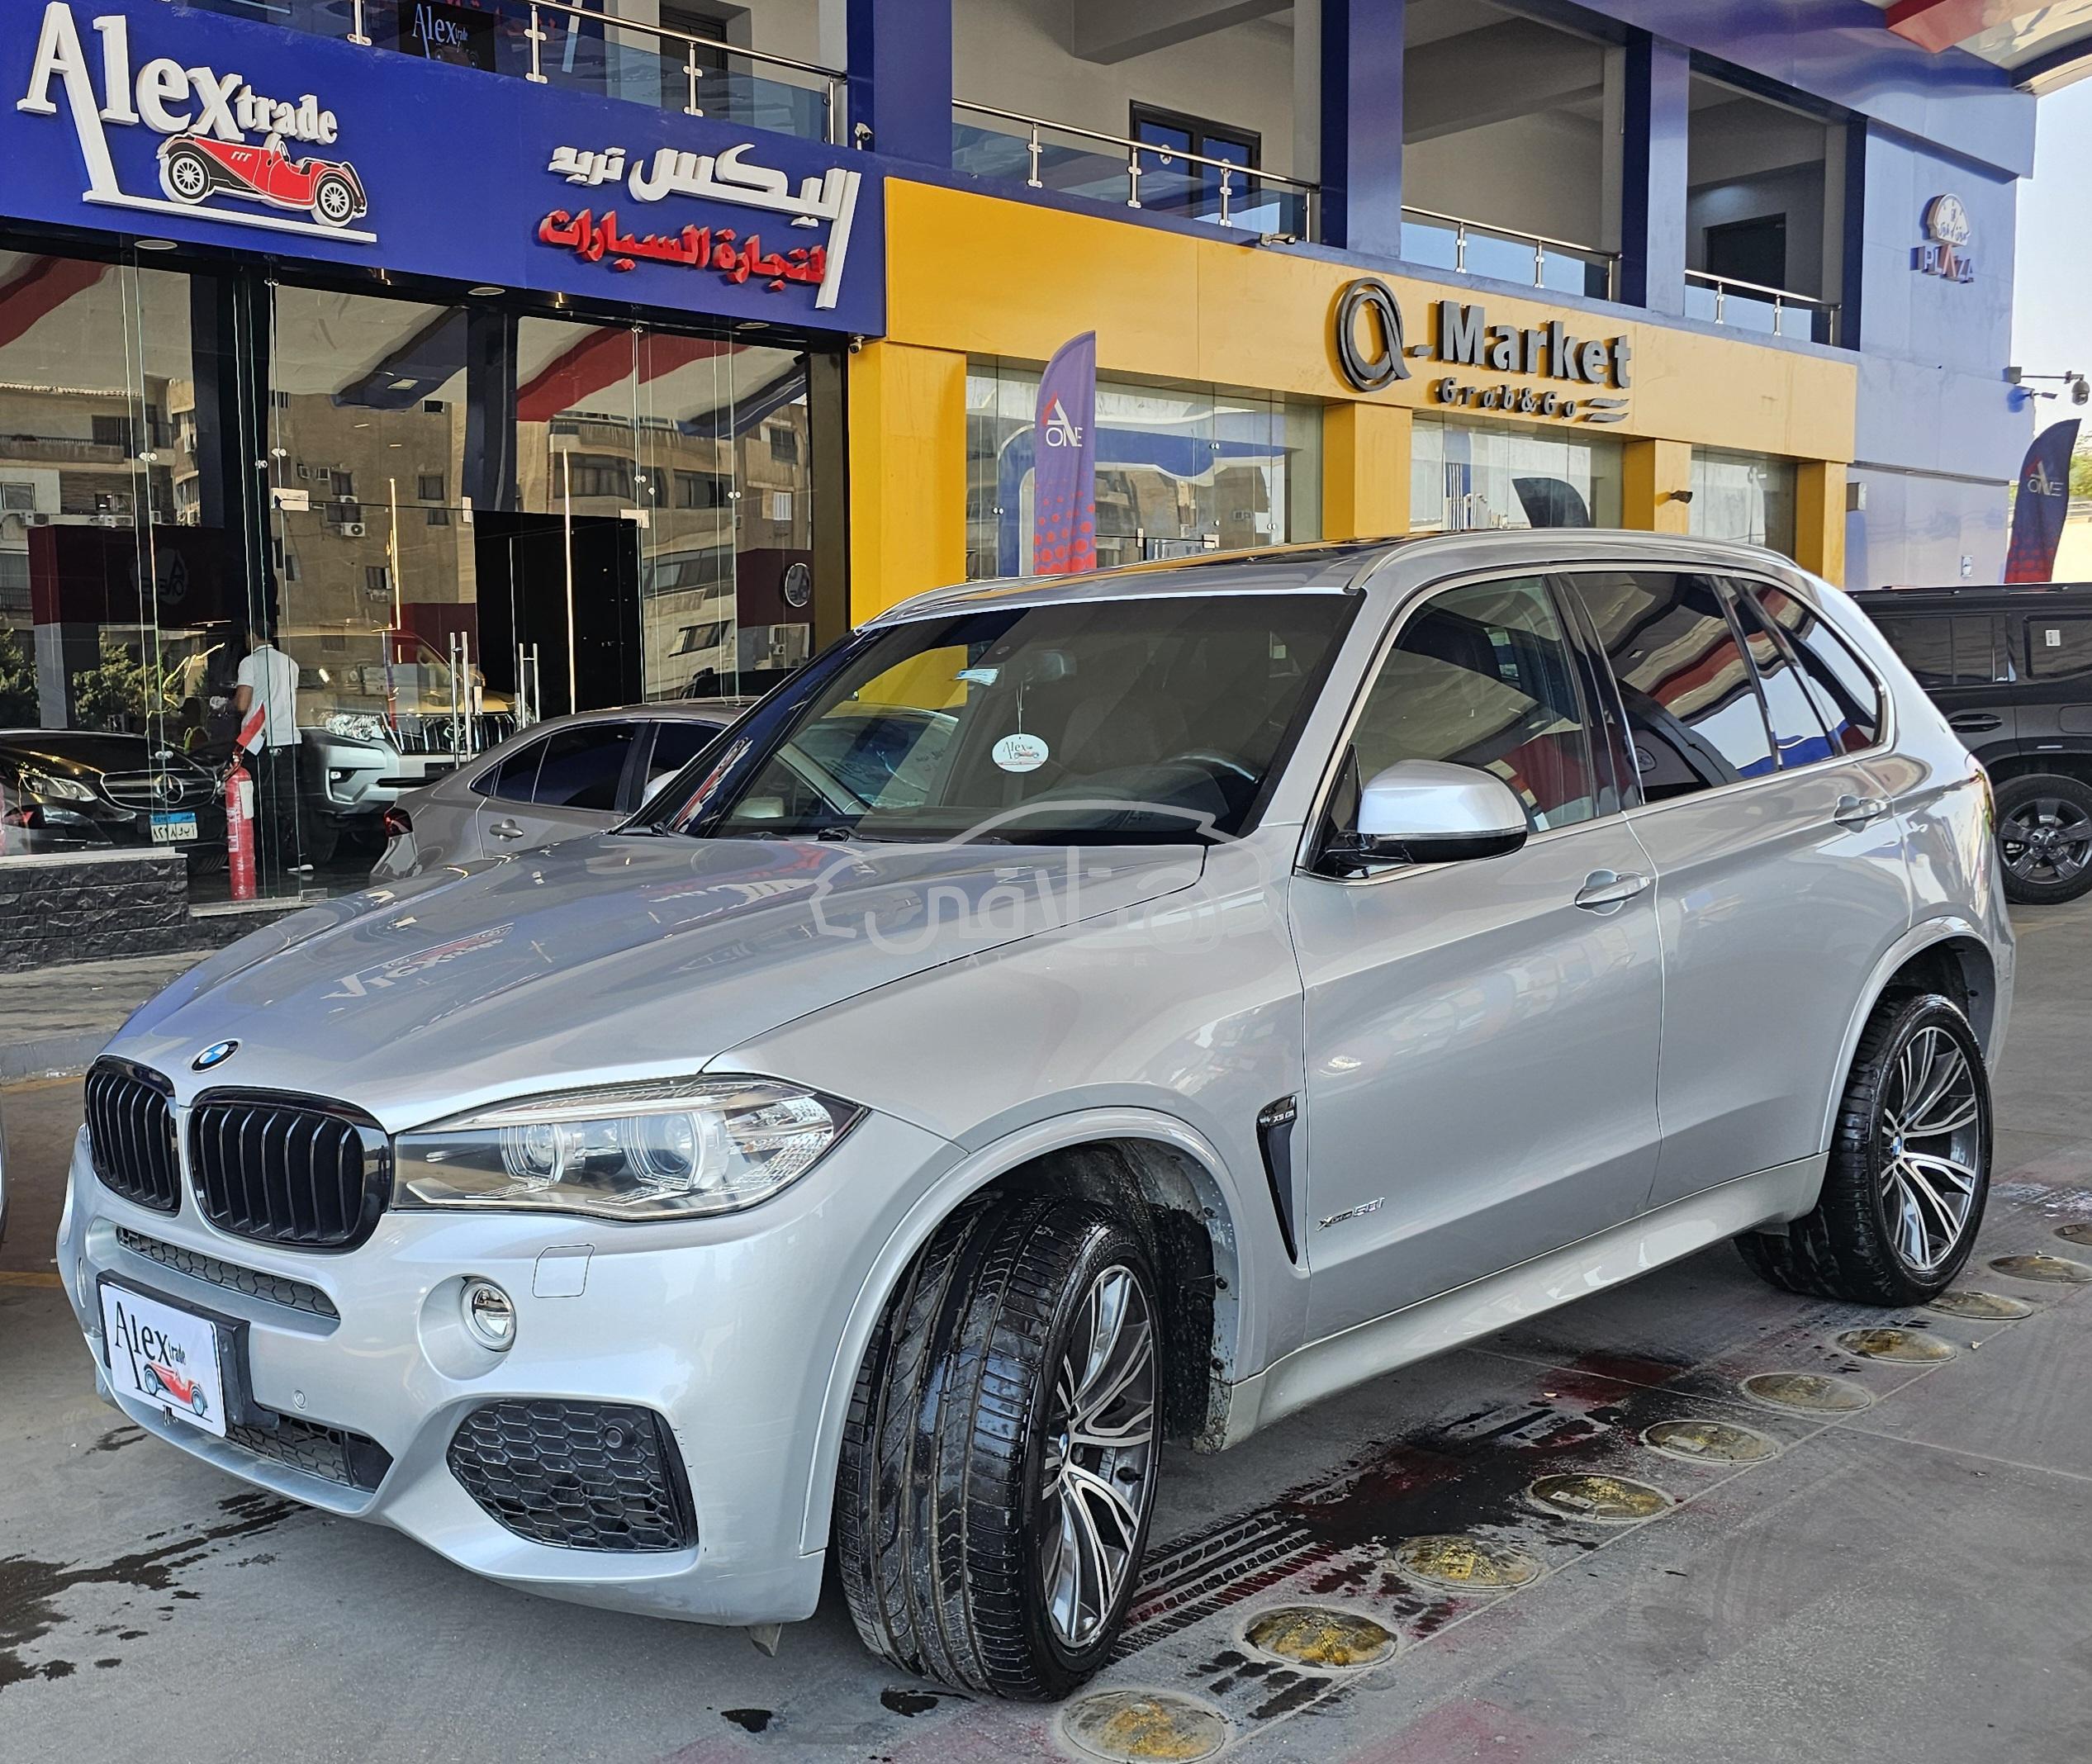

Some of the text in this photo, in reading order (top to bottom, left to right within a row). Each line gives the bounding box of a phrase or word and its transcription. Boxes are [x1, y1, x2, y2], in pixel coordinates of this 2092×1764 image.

[411, 3, 457, 59] Alex
[17, 1, 338, 205] Alex trade
[548, 146, 626, 187] تريد
[538, 208, 710, 273] السيارات
[115, 1301, 187, 1391] Alex trade
